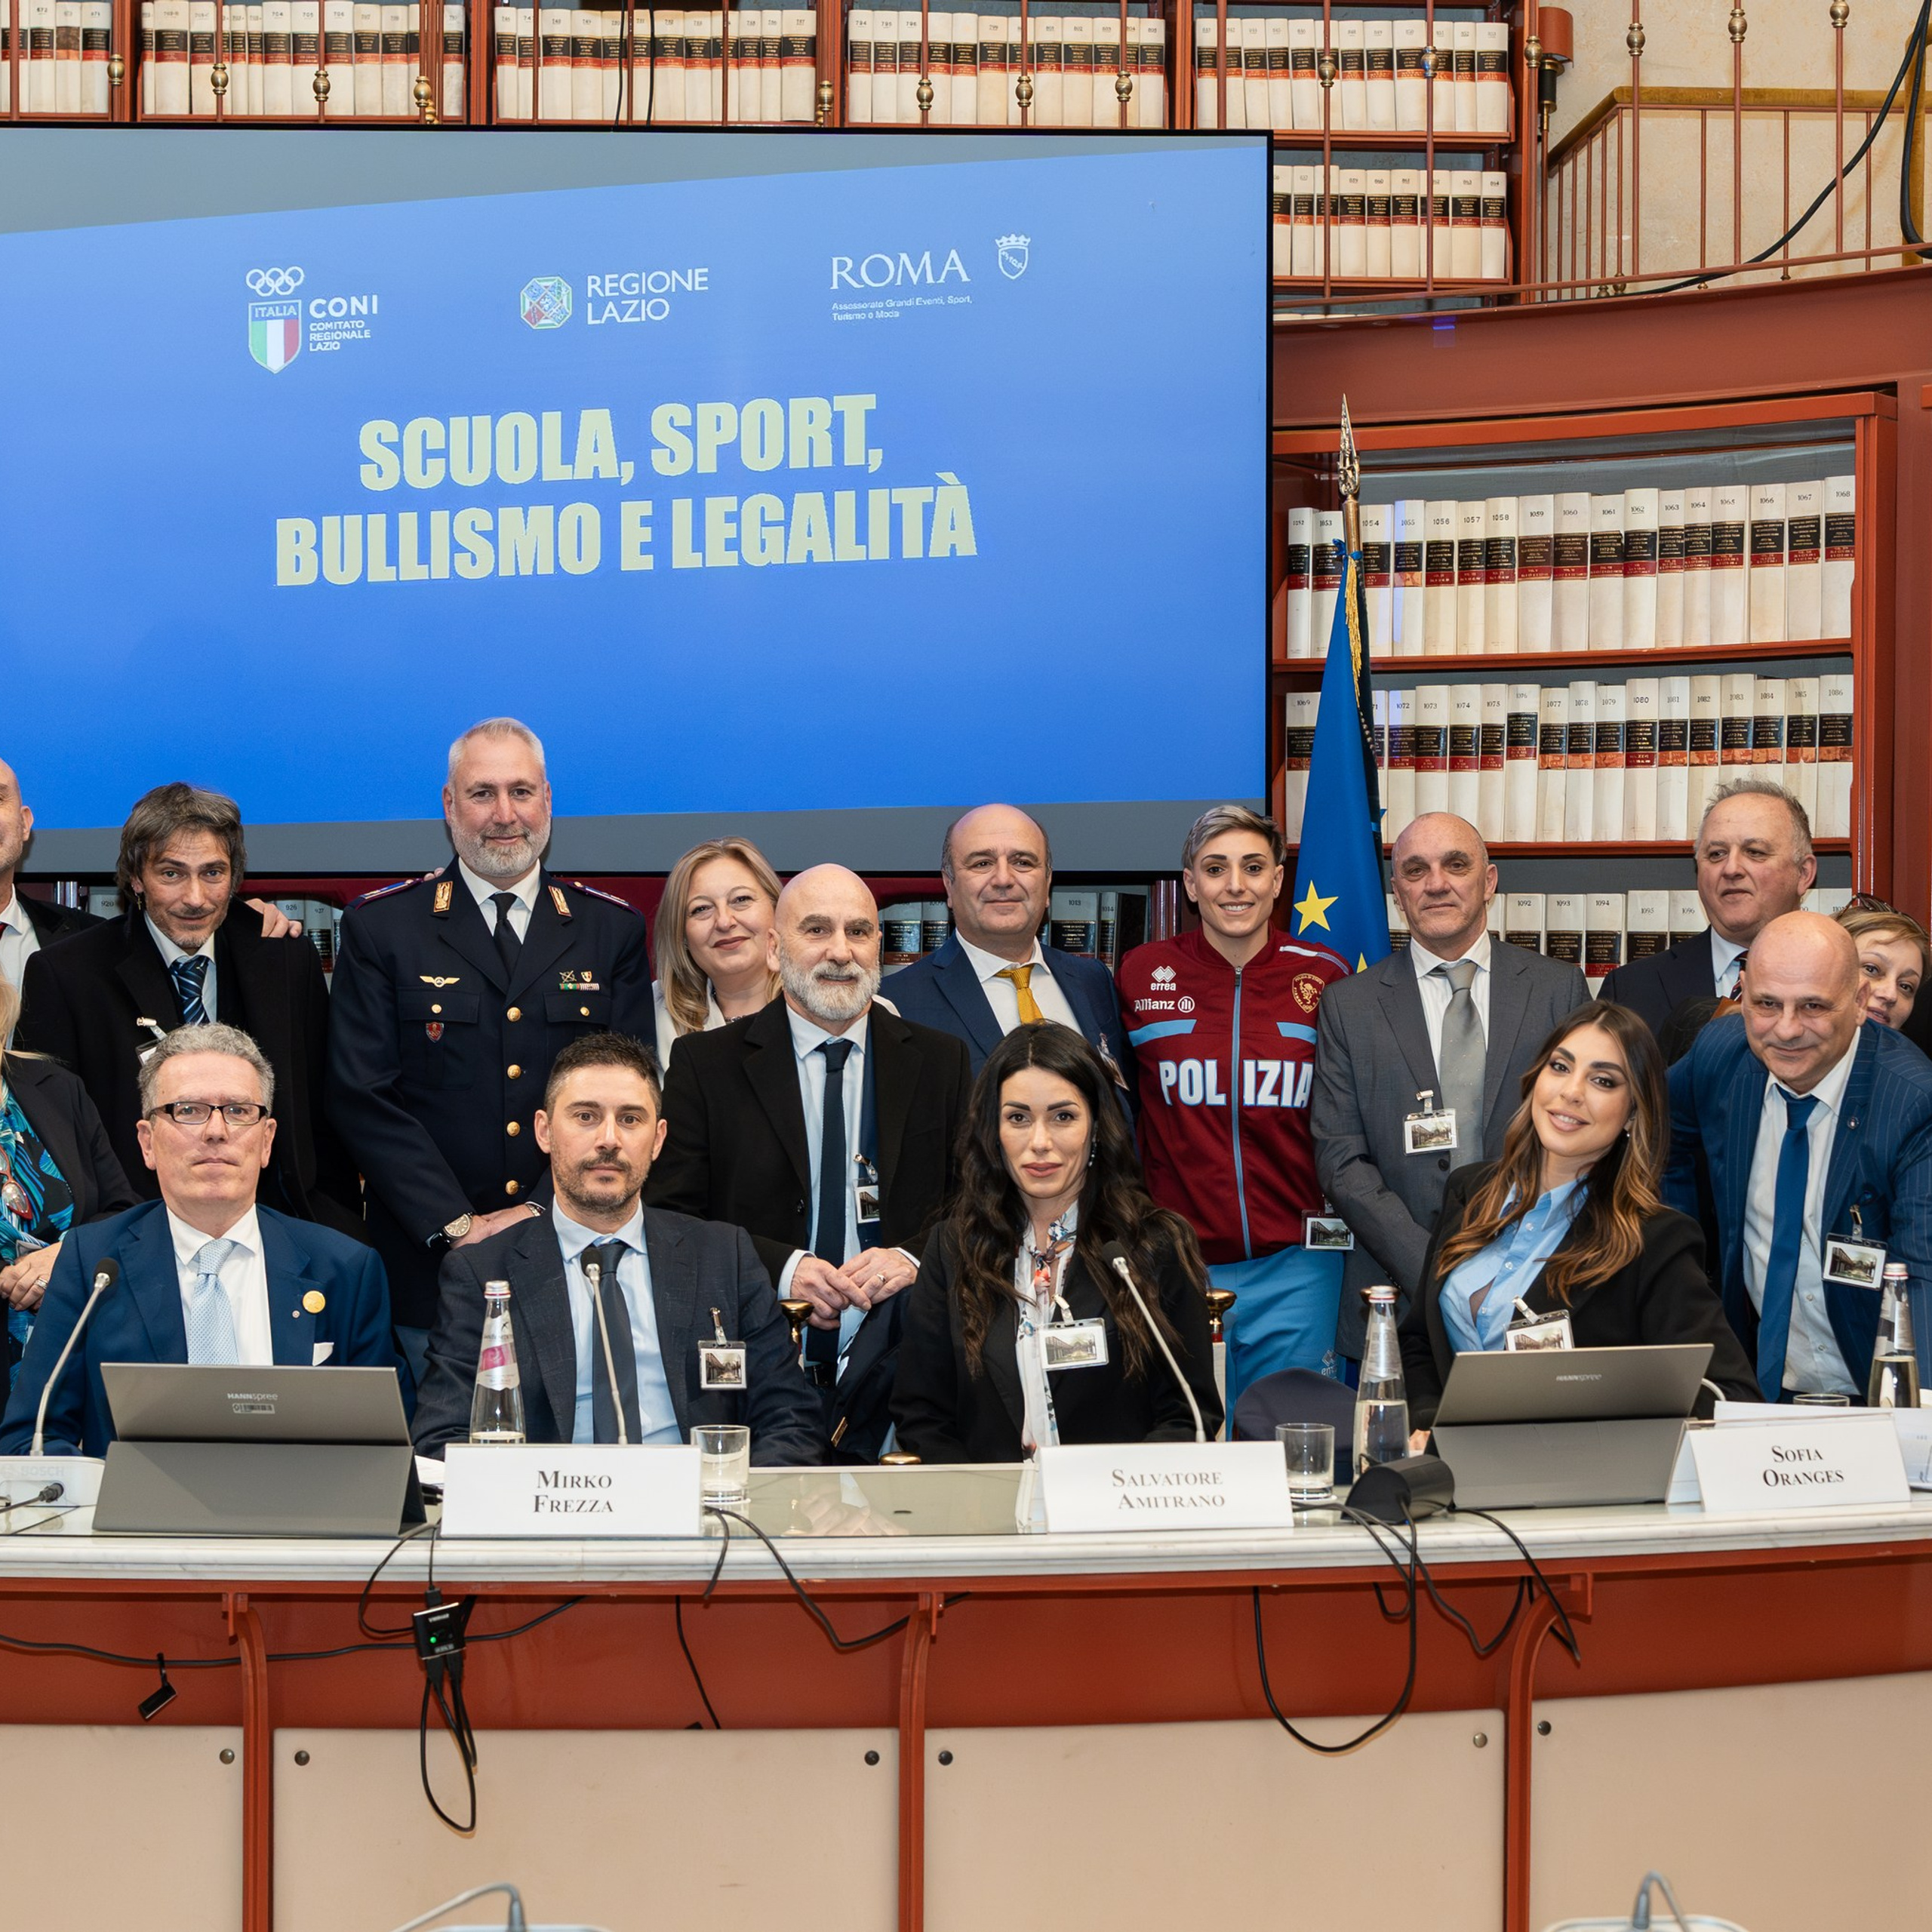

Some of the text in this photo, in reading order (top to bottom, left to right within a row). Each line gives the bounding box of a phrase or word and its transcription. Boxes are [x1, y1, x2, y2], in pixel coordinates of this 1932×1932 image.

[829, 248, 971, 290] ROMA
[586, 267, 709, 298] REGIONE
[309, 294, 378, 319] CONI
[885, 297, 915, 308] Grandi
[254, 305, 297, 318] ITALIA
[586, 297, 669, 325] LAZIO
[309, 320, 365, 331] COMITATO
[309, 329, 371, 342] REGIONALE
[309, 341, 340, 352] LAZIO
[358, 392, 883, 491] SCUOLA, SPORT,
[1835, 490, 1850, 498] 1068
[275, 471, 978, 587] BULLISMO E LEGALITÀ
[1828, 688, 1844, 697] 1086
[1150, 982, 1177, 992] errea
[1134, 998, 1175, 1012] Allianz
